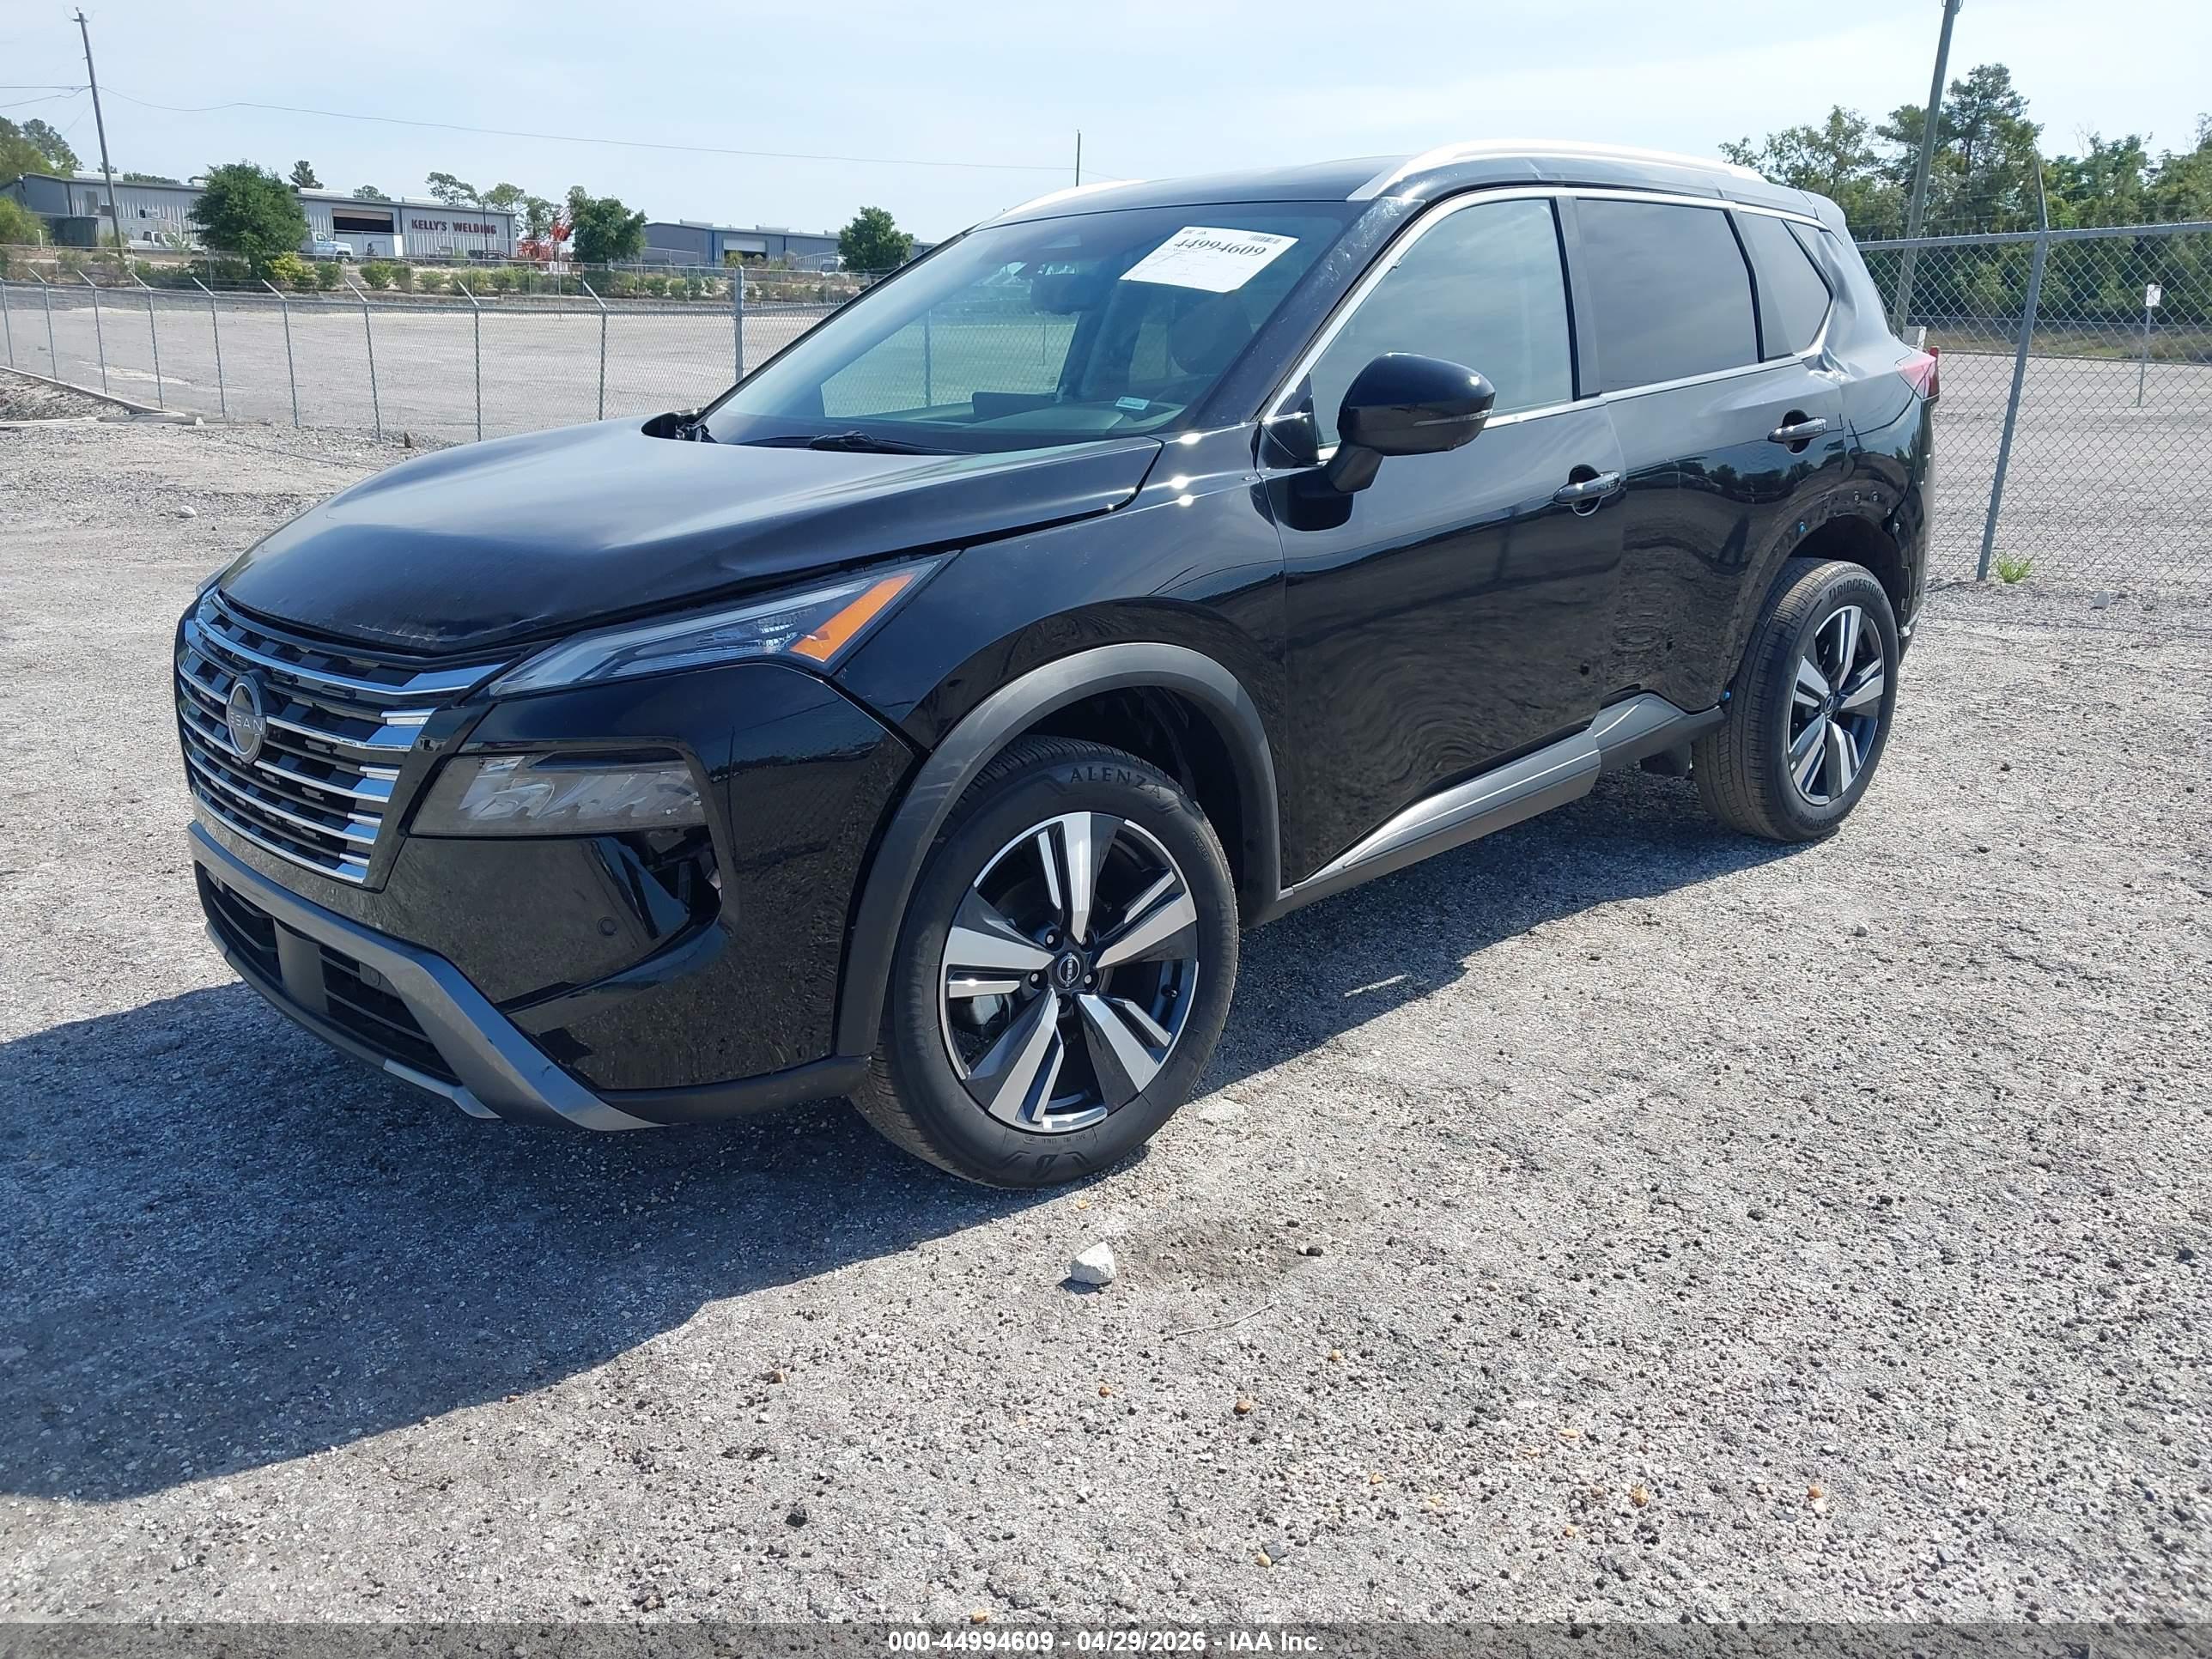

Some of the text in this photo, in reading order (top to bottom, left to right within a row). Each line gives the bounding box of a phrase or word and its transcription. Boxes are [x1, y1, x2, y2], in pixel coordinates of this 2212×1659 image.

[412, 219, 496, 234] KELLY'S WELDING
[1174, 239, 1267, 257] 44994609
[1070, 767, 1160, 799] ALENZA
